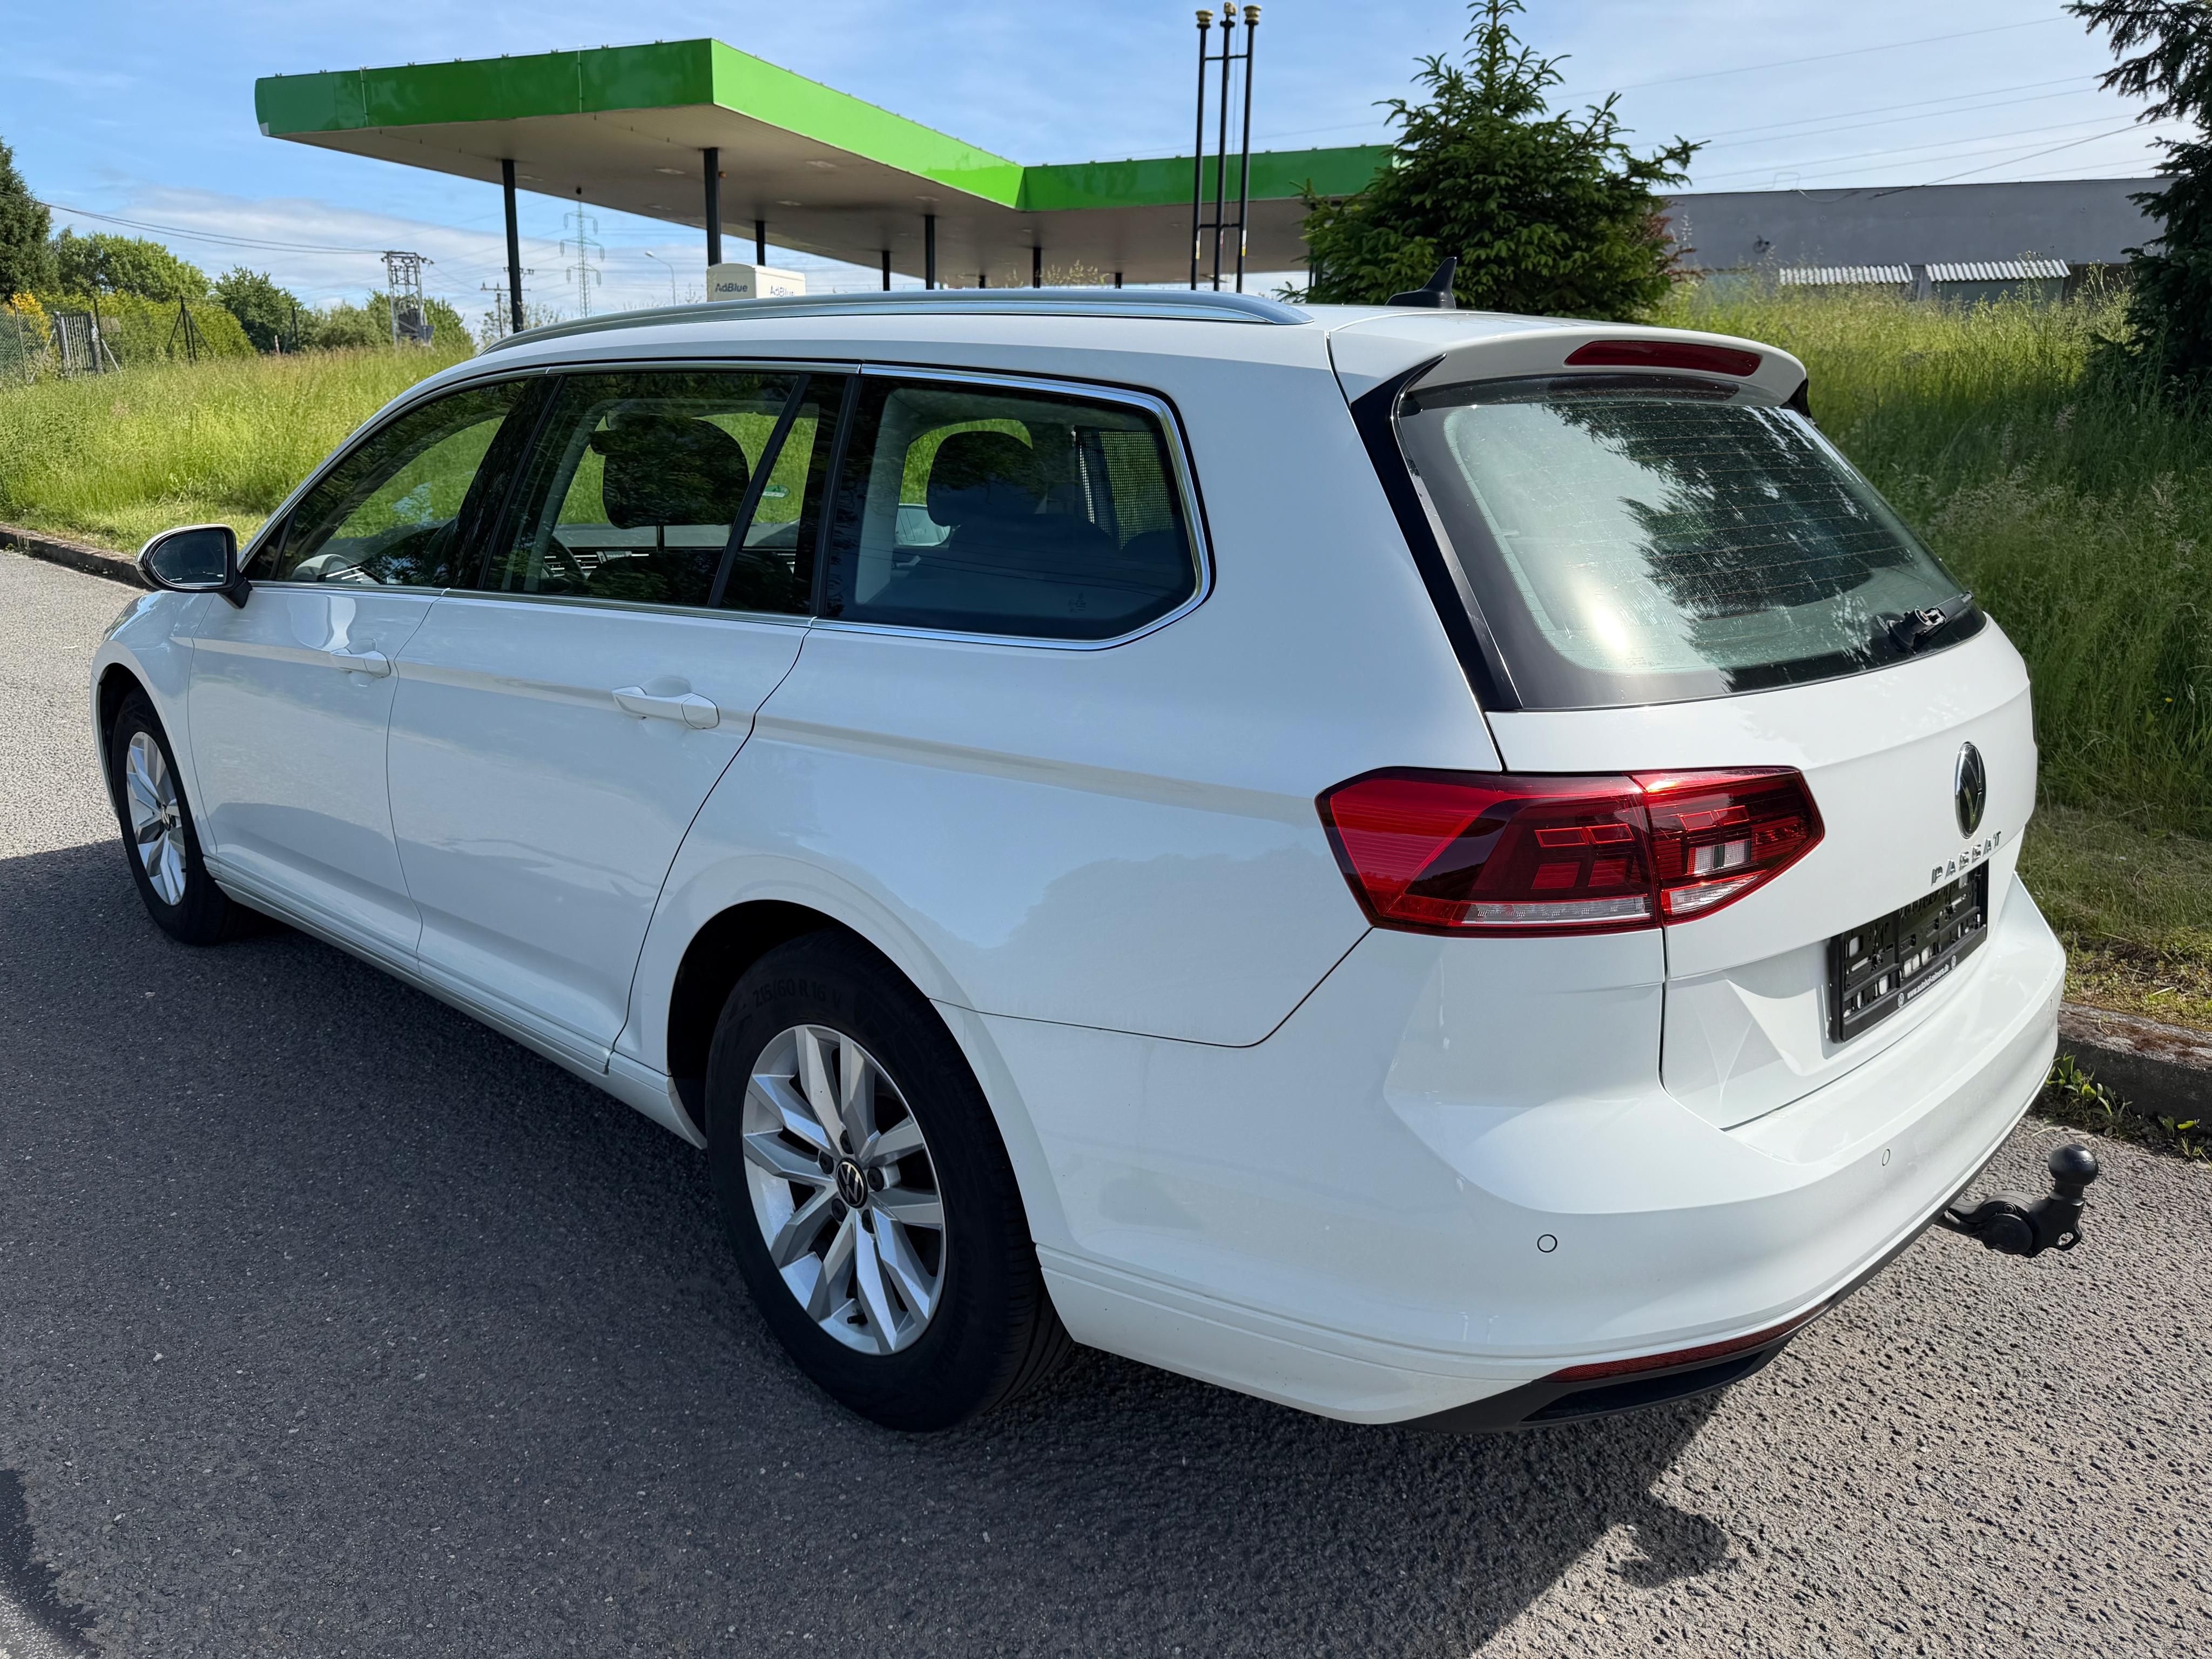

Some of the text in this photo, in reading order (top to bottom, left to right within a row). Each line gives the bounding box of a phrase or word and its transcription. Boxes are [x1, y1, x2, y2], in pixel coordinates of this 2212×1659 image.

[715, 283, 748, 292] AdBlue
[1931, 831, 2001, 887] PASSAT
[752, 978, 795, 1008] 215/60
